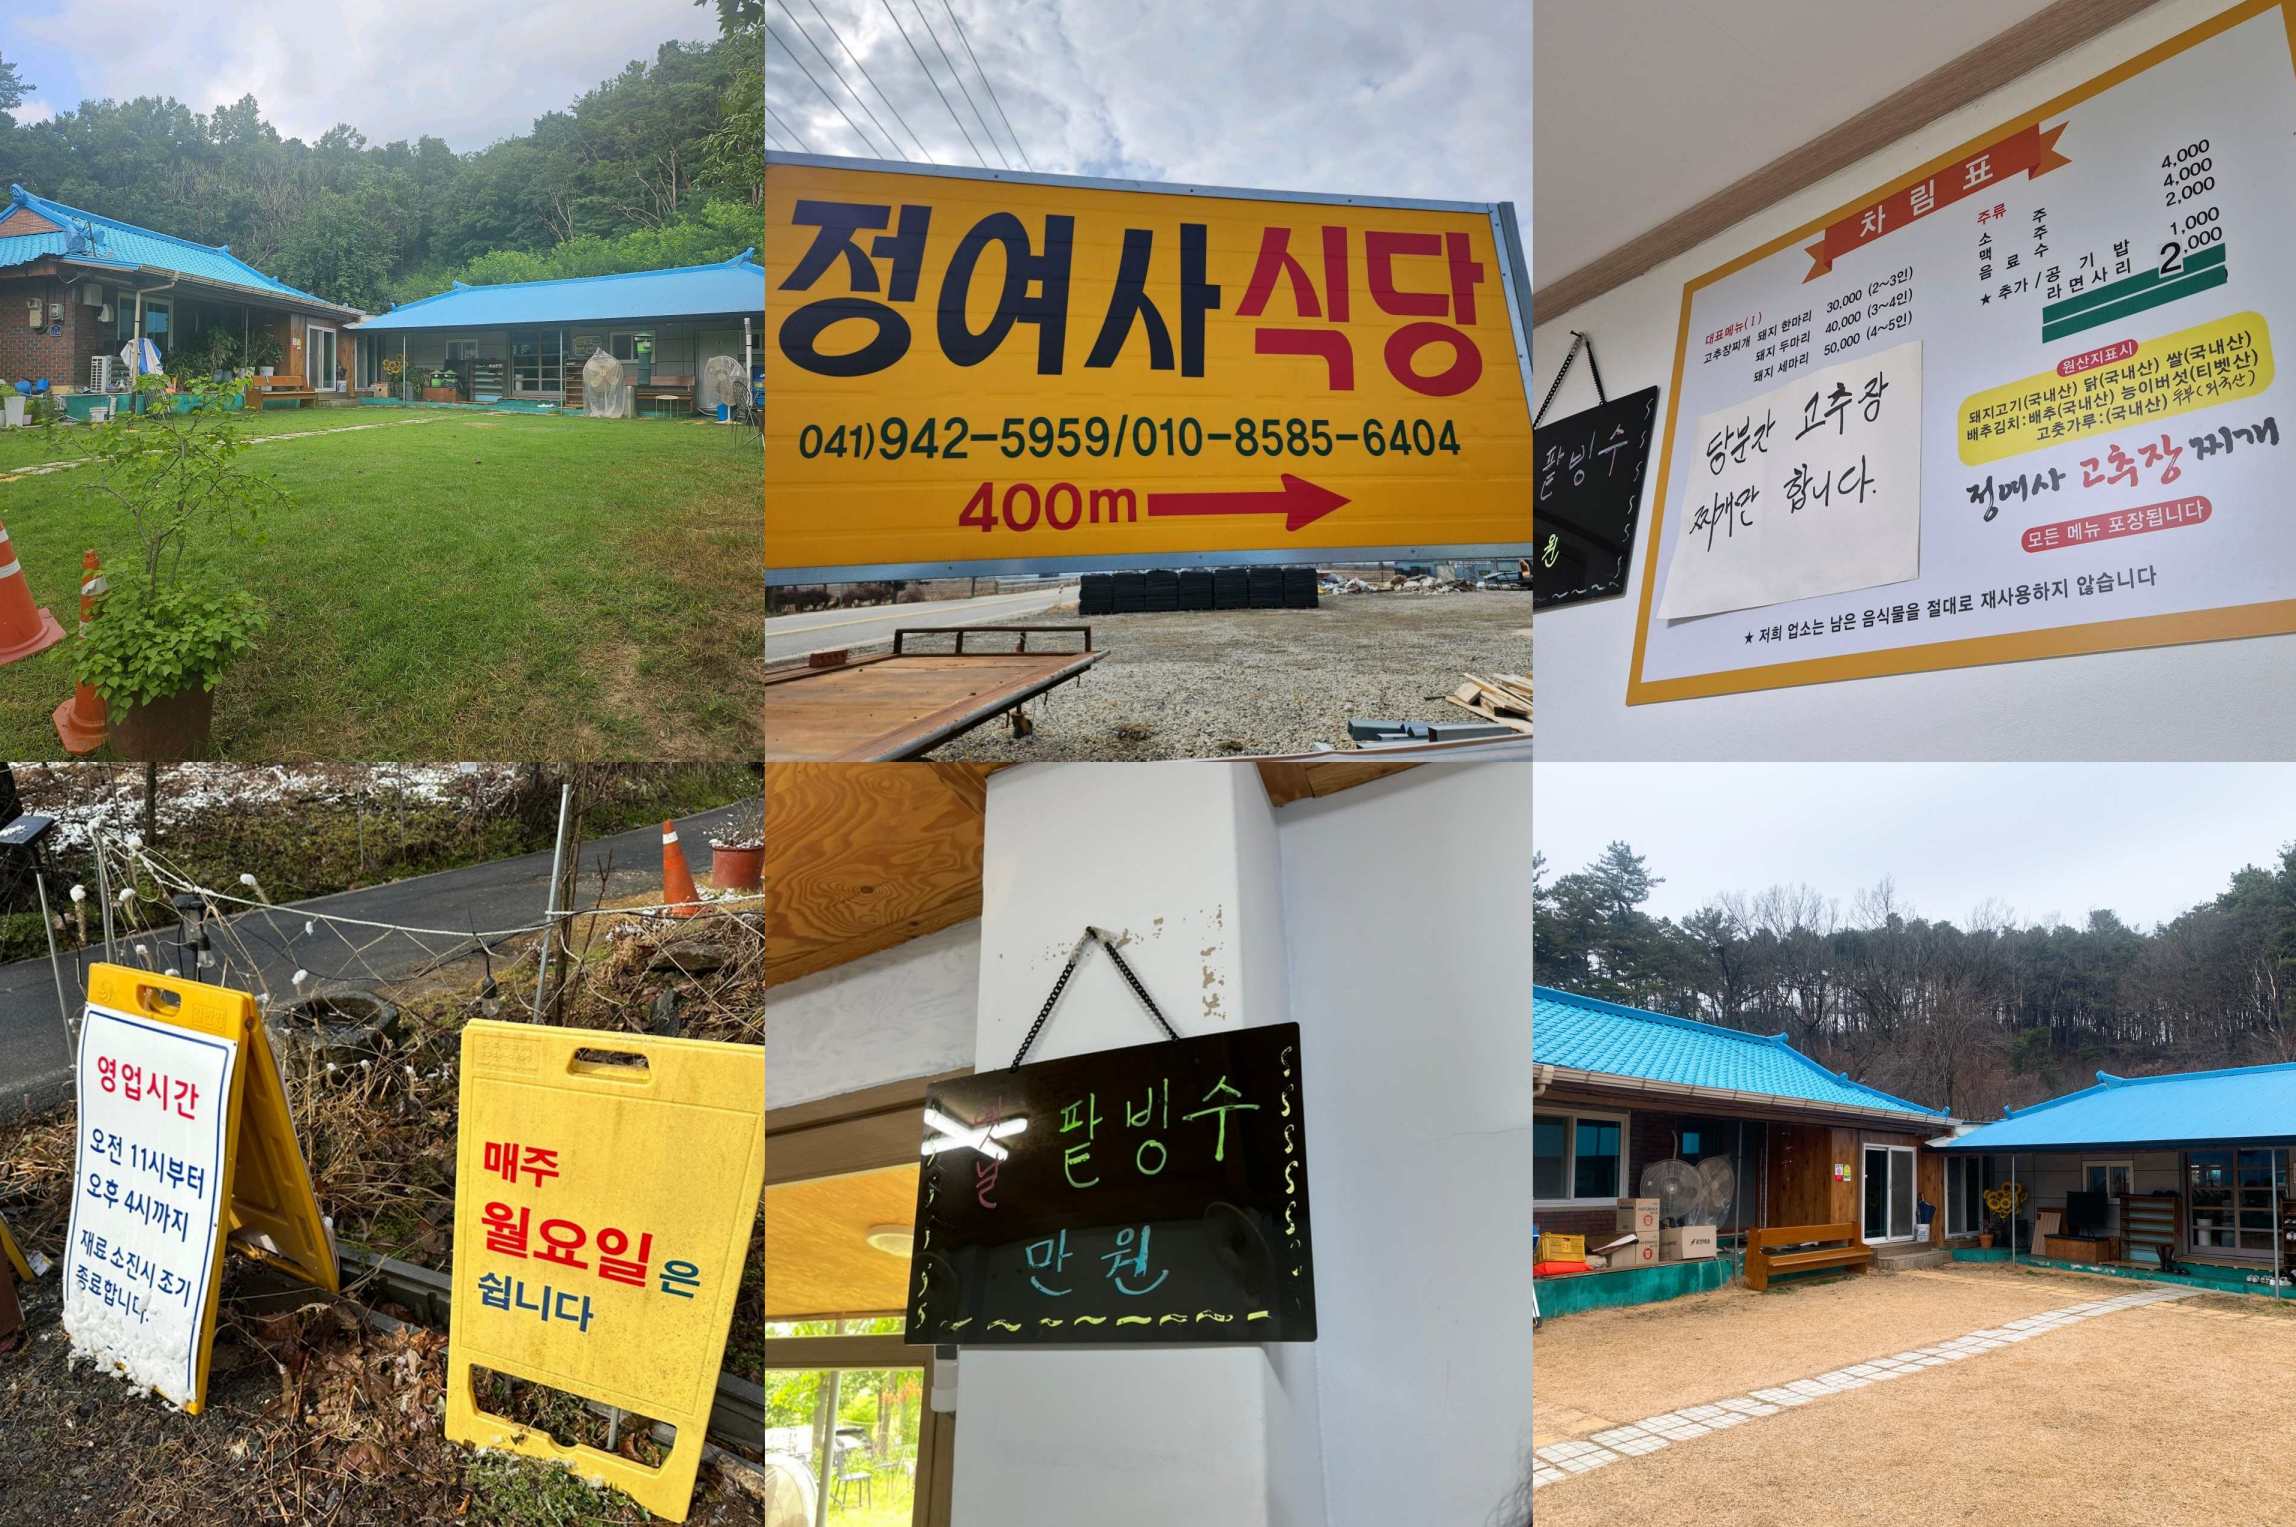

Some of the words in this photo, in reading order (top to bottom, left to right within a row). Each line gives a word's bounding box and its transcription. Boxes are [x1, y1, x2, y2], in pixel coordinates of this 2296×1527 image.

[2161, 138, 2210, 169] 4,000
[2163, 157, 2213, 188] 4,000
[1977, 202, 2007, 225] 주류
[2166, 176, 2216, 208] 2,000
[2170, 206, 2220, 237] 1,000
[2159, 226, 2223, 275] 2,000
[1704, 336, 1751, 364] 고추장찌개
[1757, 324, 1777, 341] 돼지
[1781, 309, 1812, 333] 한마리
[1826, 289, 1862, 315] 30,000
[1868, 266, 1914, 297] (2~3인)
[1753, 364, 1774, 383] 돼지
[1778, 352, 1809, 373] 세마리
[1824, 333, 1860, 357] 50,000
[1866, 311, 1913, 340] (4~5인)
[1755, 345, 1775, 362] 돼지
[1779, 330, 1810, 352] 두마리
[1825, 311, 1861, 336] 40,000
[1867, 288, 1913, 319] (3~4인)
[1968, 380, 2078, 424] 돼지고기(국내산)
[2084, 359, 2160, 394] 닭(국내산)
[2166, 330, 2253, 368] 쌀(국내산)
[2062, 341, 2135, 374] 원산지표시
[2121, 348, 2259, 400] 능이버섯(티벳산)
[1706, 408, 1776, 475] 당분간
[1795, 372, 1889, 441] 고추장
[2079, 434, 2183, 488] 고추장
[2189, 416, 2280, 460] 찌개
[958, 480, 1138, 533] 400m
[1689, 485, 1760, 552] 찌개만
[1784, 454, 1877, 514] 합니다.
[2027, 526, 2060, 549] 모든
[2067, 519, 2102, 542] 메뉴
[2108, 500, 2205, 534] 포장됩니다
[1759, 623, 1782, 645] 저희
[1787, 617, 1825, 641] 업소는
[1830, 612, 1857, 633] 남은
[1862, 601, 1921, 629] 음식물을
[1927, 594, 1974, 619] 절대로
[1980, 578, 2069, 609] 재사용하지
[2077, 564, 2157, 597] 않습니다
[97, 1055, 200, 1121] 영업시간
[89, 1128, 122, 1167] 오전
[130, 1143, 206, 1200] 11시부터
[483, 1140, 560, 1188] 매주
[86, 1173, 119, 1210] 오후
[124, 1190, 189, 1243] 4시까지
[80, 1229, 107, 1260] 재료
[158, 1269, 191, 1308] 조기
[477, 1270, 595, 1333] 쉽니다
